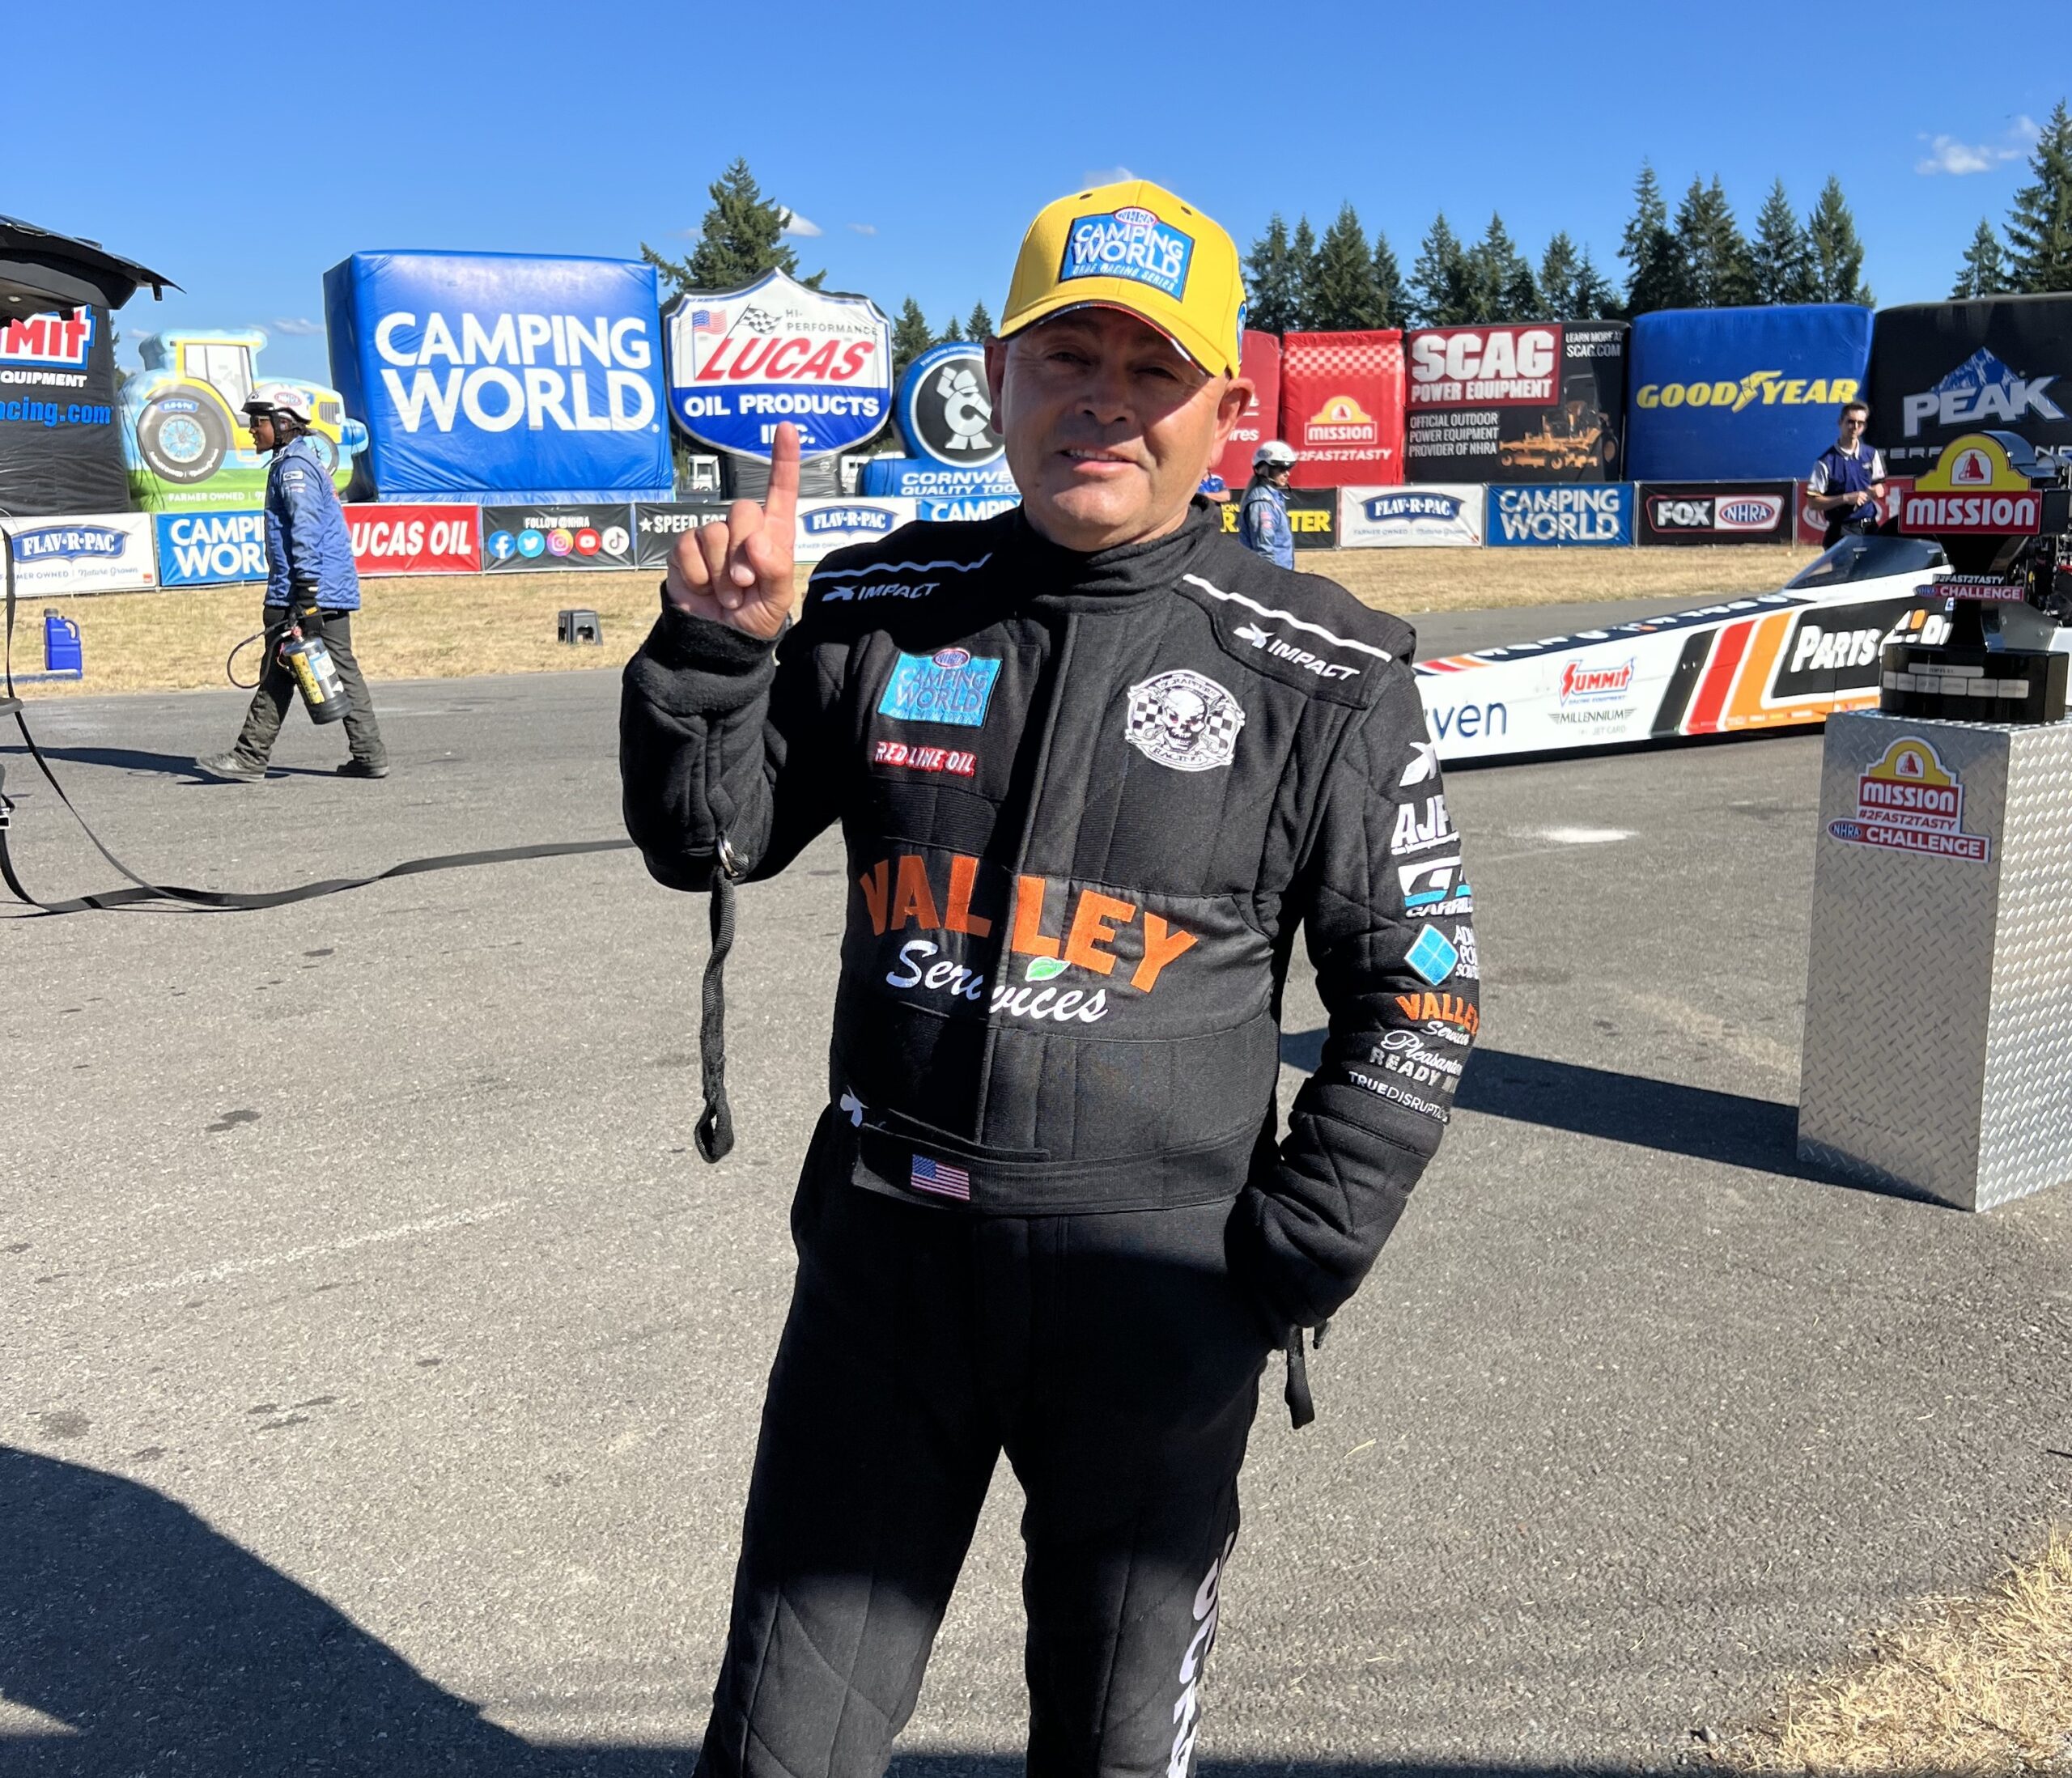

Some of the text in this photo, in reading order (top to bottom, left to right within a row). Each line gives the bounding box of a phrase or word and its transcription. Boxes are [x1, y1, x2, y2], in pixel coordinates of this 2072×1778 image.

[1075, 223, 1184, 261] CAMPING
[1073, 240, 1181, 278] WORLD
[1141, 270, 1175, 291] SERIES
[786, 309, 803, 319] HI-
[375, 312, 651, 369] CAMPING
[787, 322, 877, 336] PERFORMANCE
[1565, 332, 1590, 343] LEARN
[1590, 330, 1614, 342] MORE
[695, 337, 875, 381] LUCAS
[1412, 329, 1555, 383] SCAG
[1566, 343, 1621, 358] SCAG.COM
[0, 370, 87, 388] QUIPMENT
[1412, 379, 1552, 403] POWER EQUIPMENT
[380, 367, 656, 433] WORLD
[1637, 376, 1859, 409] GOODYEAR
[684, 393, 880, 418] OIL PRODUCTS
[1904, 376, 2065, 438] PEAK
[1410, 412, 1497, 429] OFFICIAL OUTDOOR
[1308, 426, 1374, 441] MISSION
[1409, 427, 1499, 443] POWER EQUIPMENT
[1409, 442, 1497, 458] PROVIDER OF NHRA
[901, 484, 1016, 496] QUALITY TOO
[902, 471, 1013, 486] CORNWE
[168, 493, 208, 503] FARMER
[210, 491, 245, 502] OWNED
[1499, 488, 1619, 513] CAMPING
[524, 516, 590, 529] FOLLOW @NHRA
[654, 514, 698, 533] SPEED
[1657, 500, 1768, 526] FOX NHRA
[1906, 498, 2035, 526] MISSION
[171, 515, 265, 545] CAMPI
[351, 520, 472, 557] UCAS OIL
[1499, 512, 1620, 541] WORLD
[36, 570, 69, 579] OWNED
[858, 582, 940, 600] IMPACT
[1939, 586, 2021, 600] CHALLENGE
[1267, 639, 1361, 681] IMPACT
[1790, 625, 1882, 673] PARTS
[898, 666, 990, 691] CAMPING
[1562, 663, 1630, 698] SUMMIT
[895, 683, 983, 713] WORLD
[1425, 702, 1507, 740] ven
[1560, 709, 1624, 724] MILLENNIUM
[1592, 725, 1626, 736] JET CARD
[875, 741, 975, 772] RED LINE OIL
[1153, 747, 1204, 762] RACING
[1862, 781, 1955, 813] MISSION
[1859, 808, 1957, 831] #2FAST2TASTY
[1832, 824, 1981, 856] NHRA CHALLENGE
[860, 855, 1199, 994] VALLEY
[1369, 1046, 1441, 1087] READY
